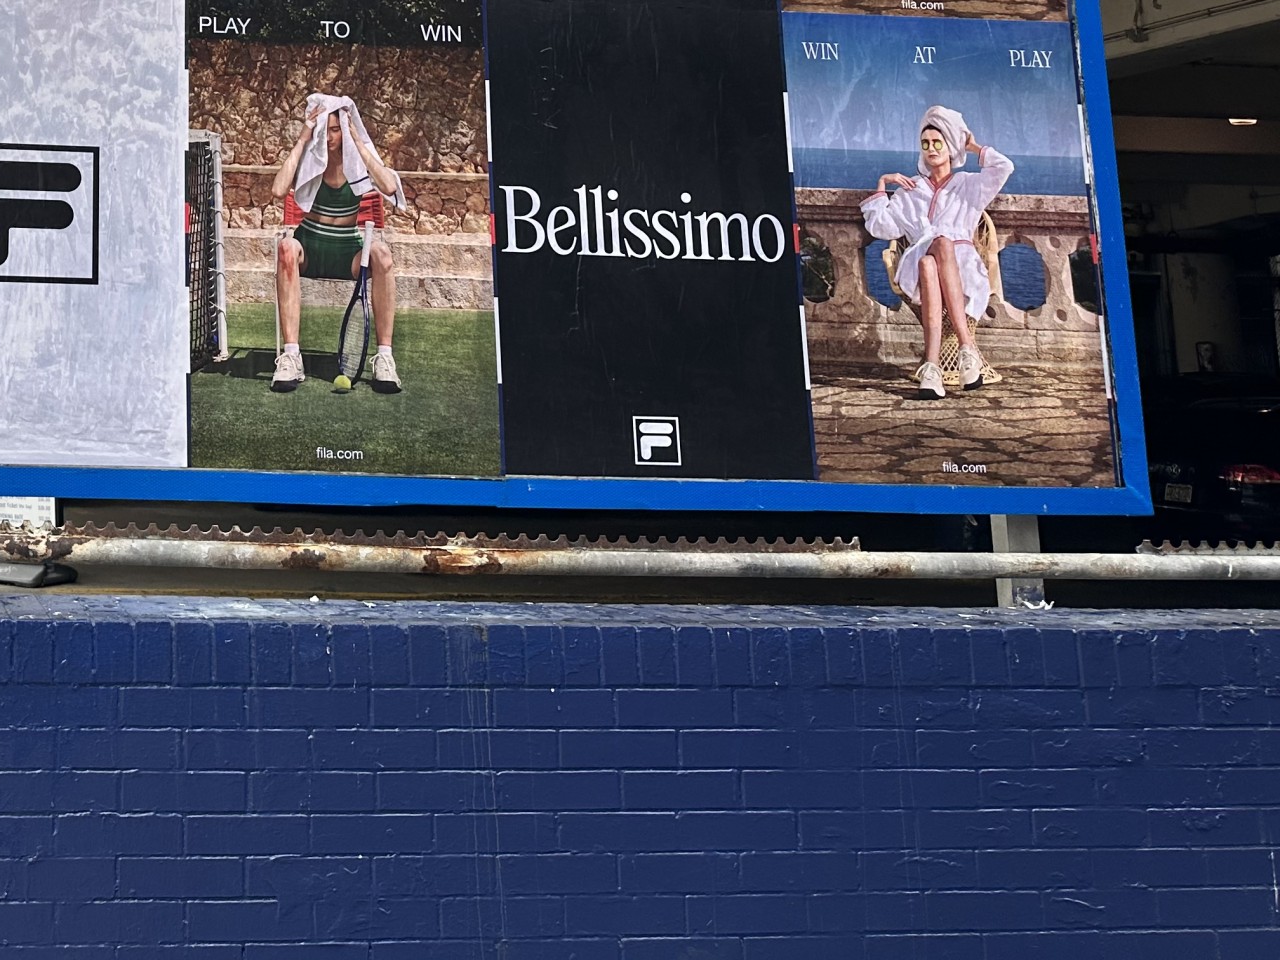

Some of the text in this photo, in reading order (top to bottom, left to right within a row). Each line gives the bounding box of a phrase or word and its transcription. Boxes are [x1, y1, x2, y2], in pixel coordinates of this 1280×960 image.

[198, 16, 462, 43] PLAY TO WIN
[802, 42, 1053, 70] WIN AT PLAY
[499, 184, 785, 264] Bellissimo
[315, 446, 364, 460] fila.com
[942, 461, 987, 474] fila.com
